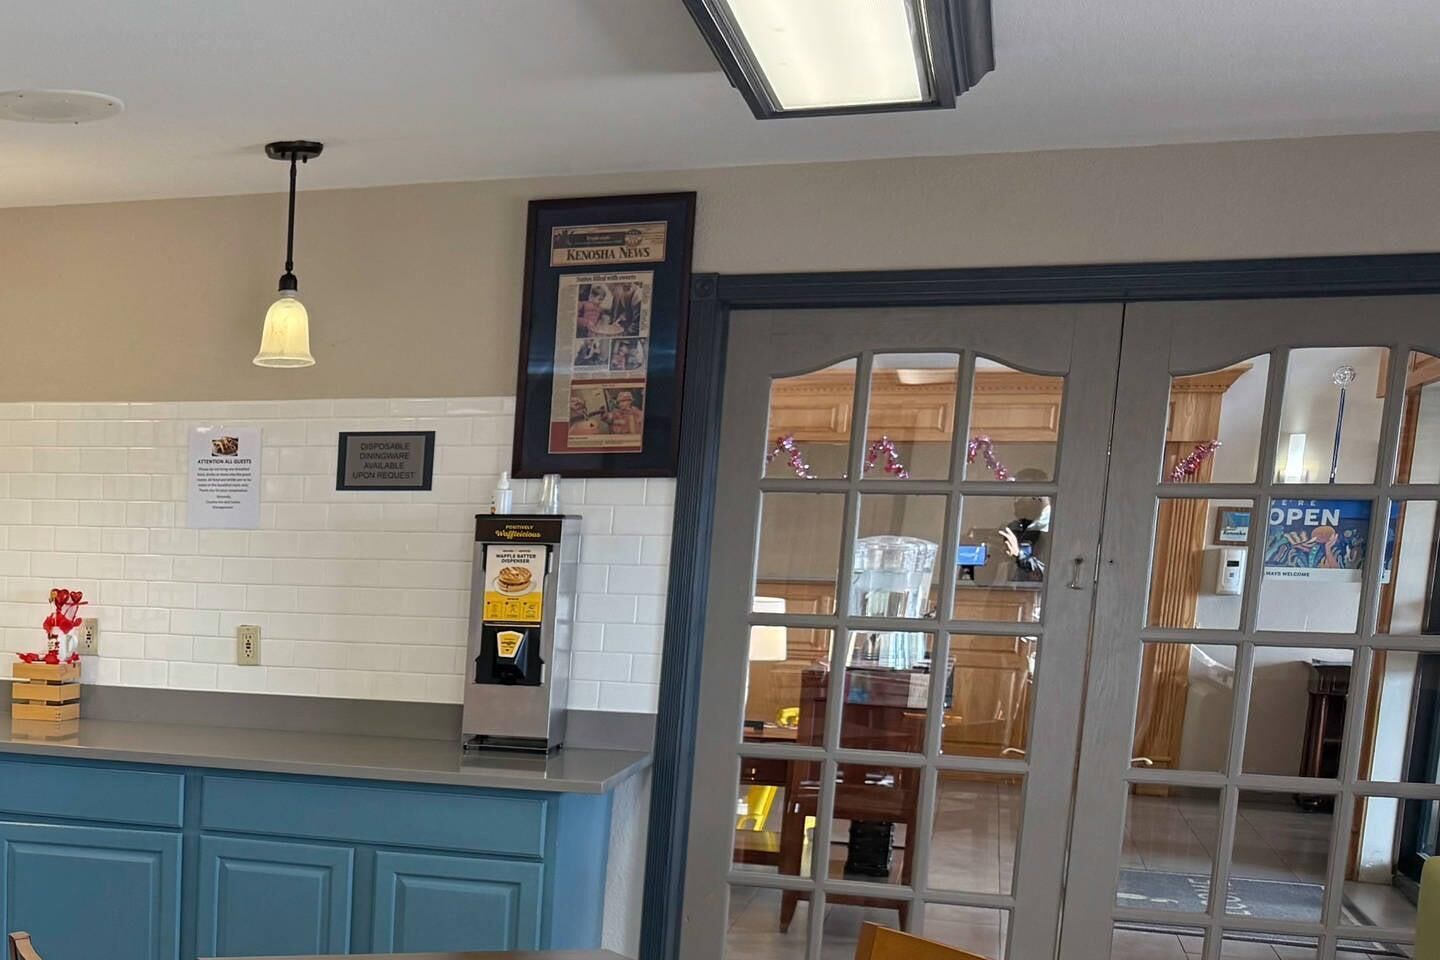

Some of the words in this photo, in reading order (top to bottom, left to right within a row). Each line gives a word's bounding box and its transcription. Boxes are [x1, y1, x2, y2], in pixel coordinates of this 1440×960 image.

[566, 248, 616, 261] KENOSHA
[619, 246, 651, 259] NEWS
[360, 442, 410, 450] DISPOSABLE
[359, 452, 409, 460] DININGWARE
[363, 462, 405, 470] AVAILABLE
[352, 471, 375, 480] UPON
[376, 471, 417, 480] REQUEST
[1271, 499, 1316, 507] E'RE
[1270, 507, 1340, 526] OPEN
